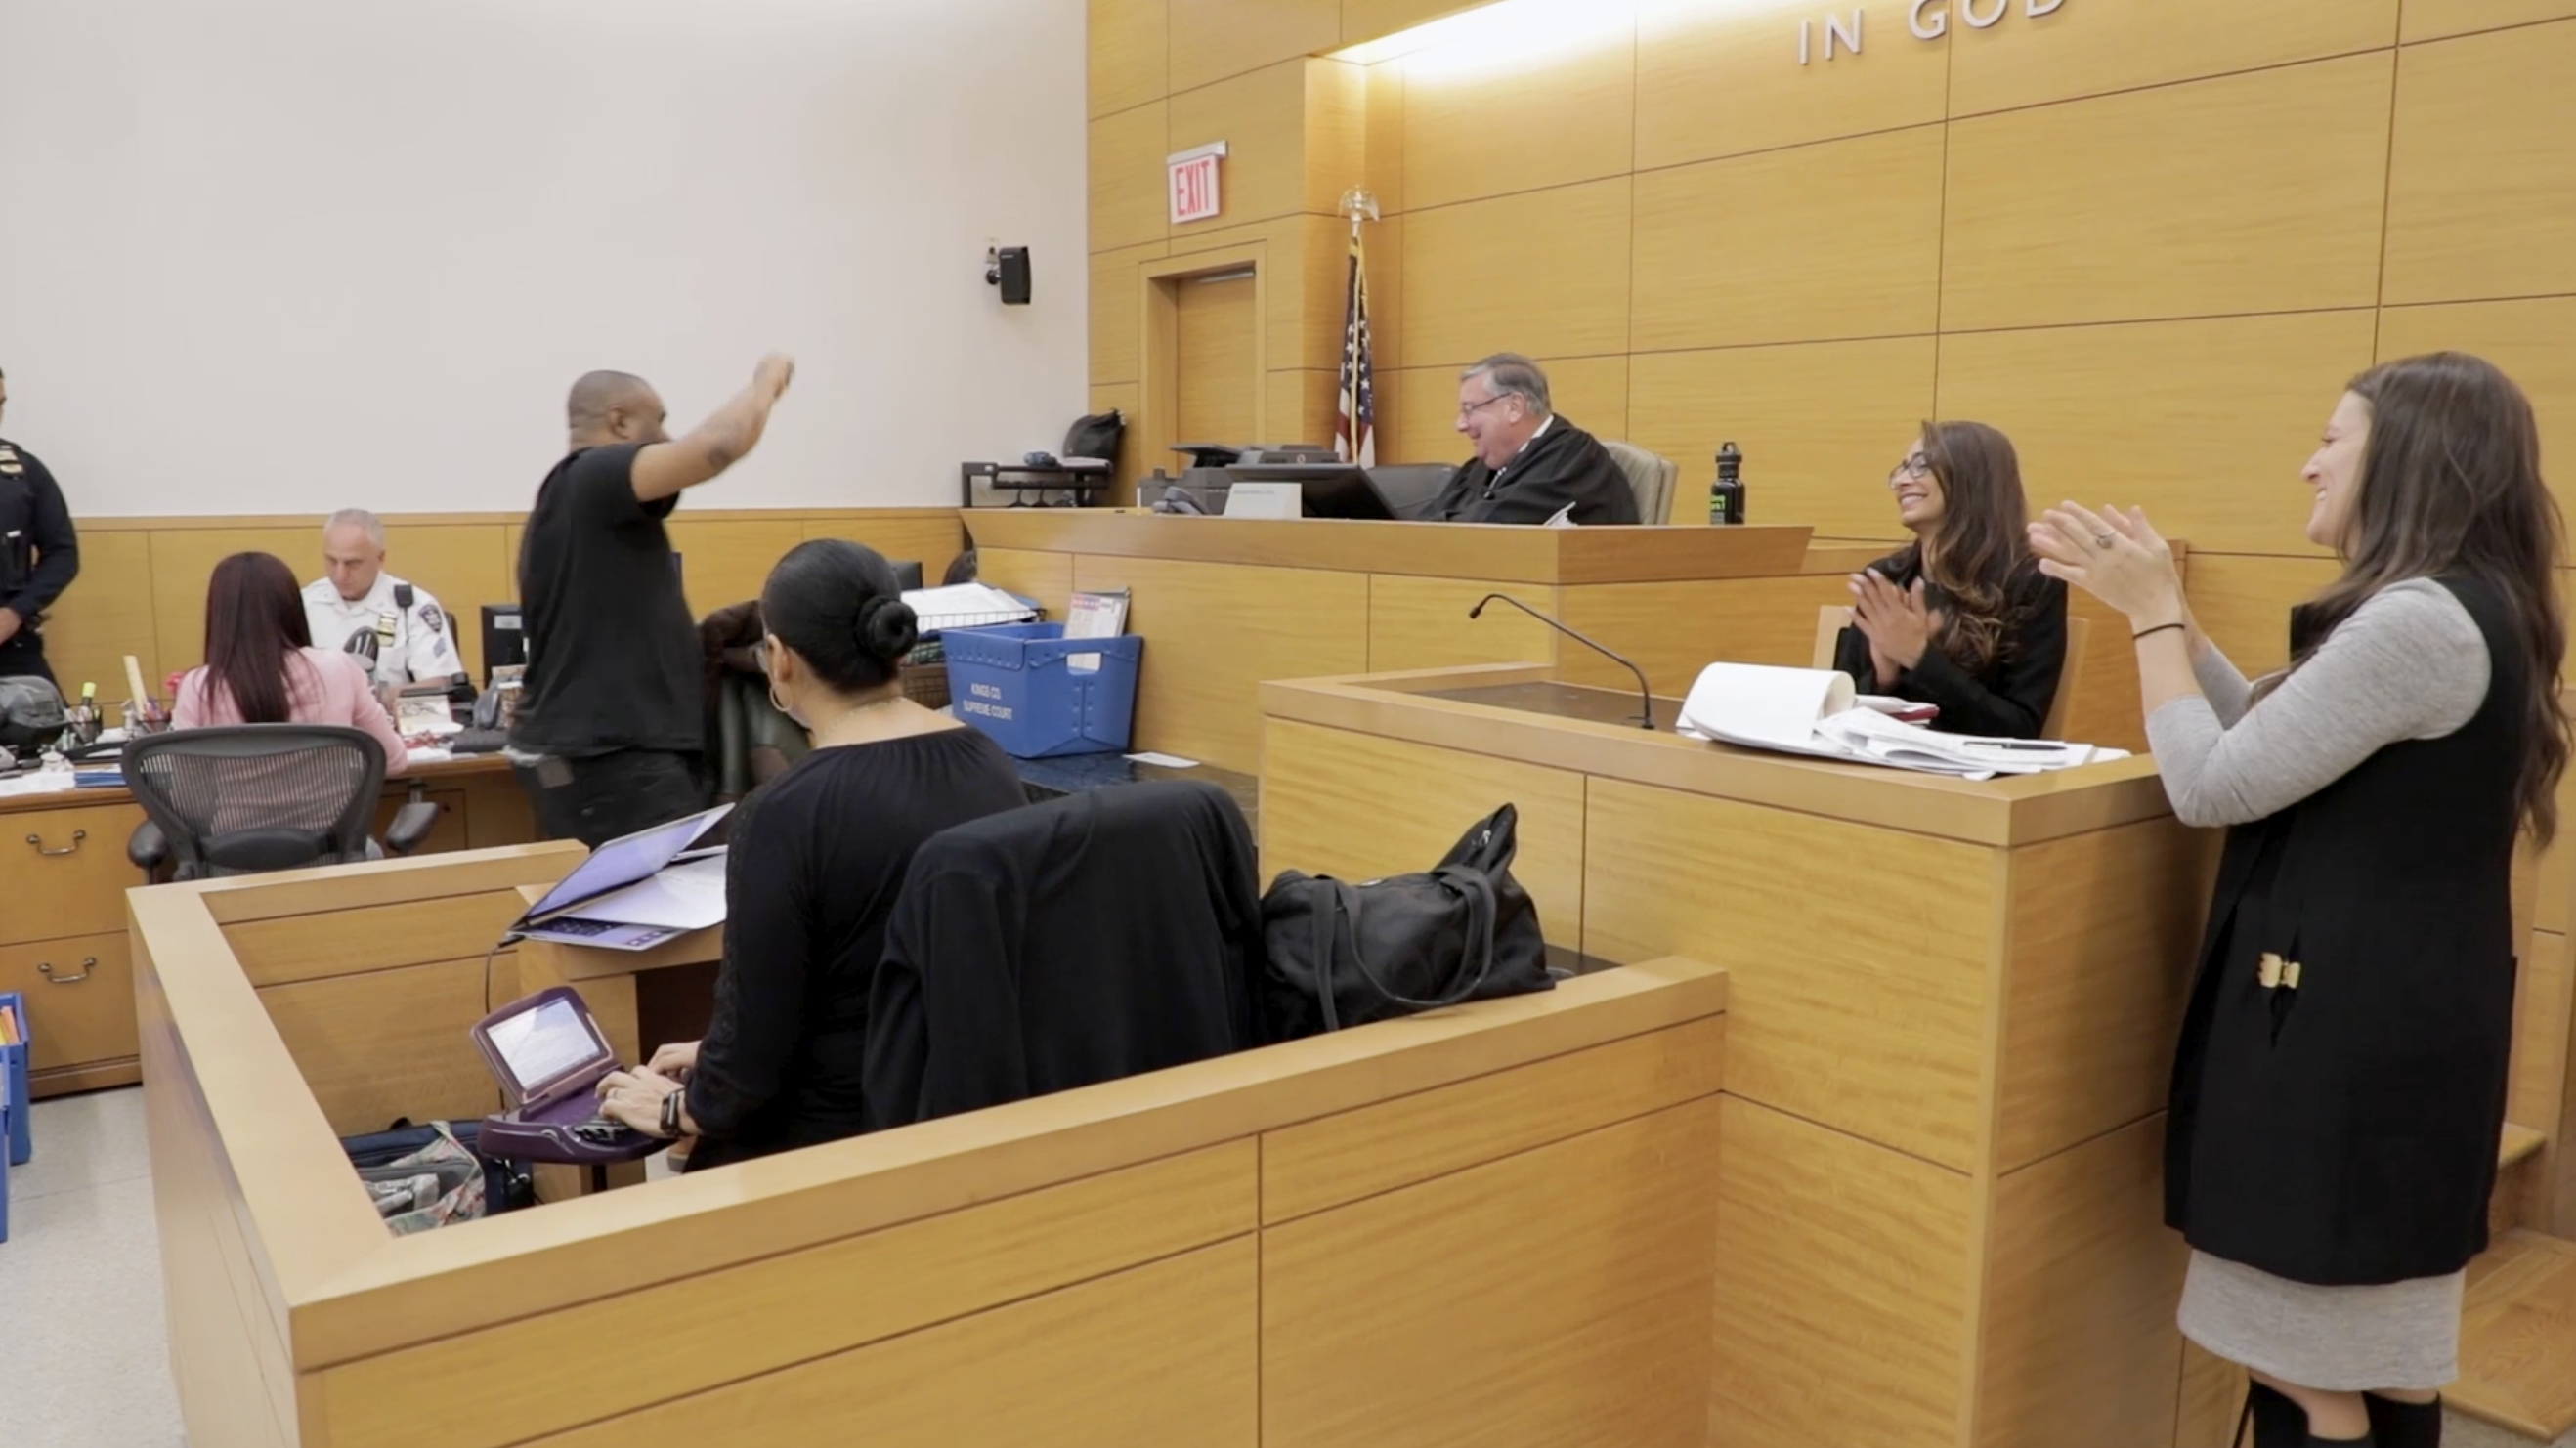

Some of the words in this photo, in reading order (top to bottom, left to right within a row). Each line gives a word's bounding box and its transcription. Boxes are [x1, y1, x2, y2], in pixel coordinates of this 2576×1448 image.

[1799, 8, 1863, 65] IN
[1176, 159, 1210, 216] EXIT
[992, 705, 1012, 720] COURT
